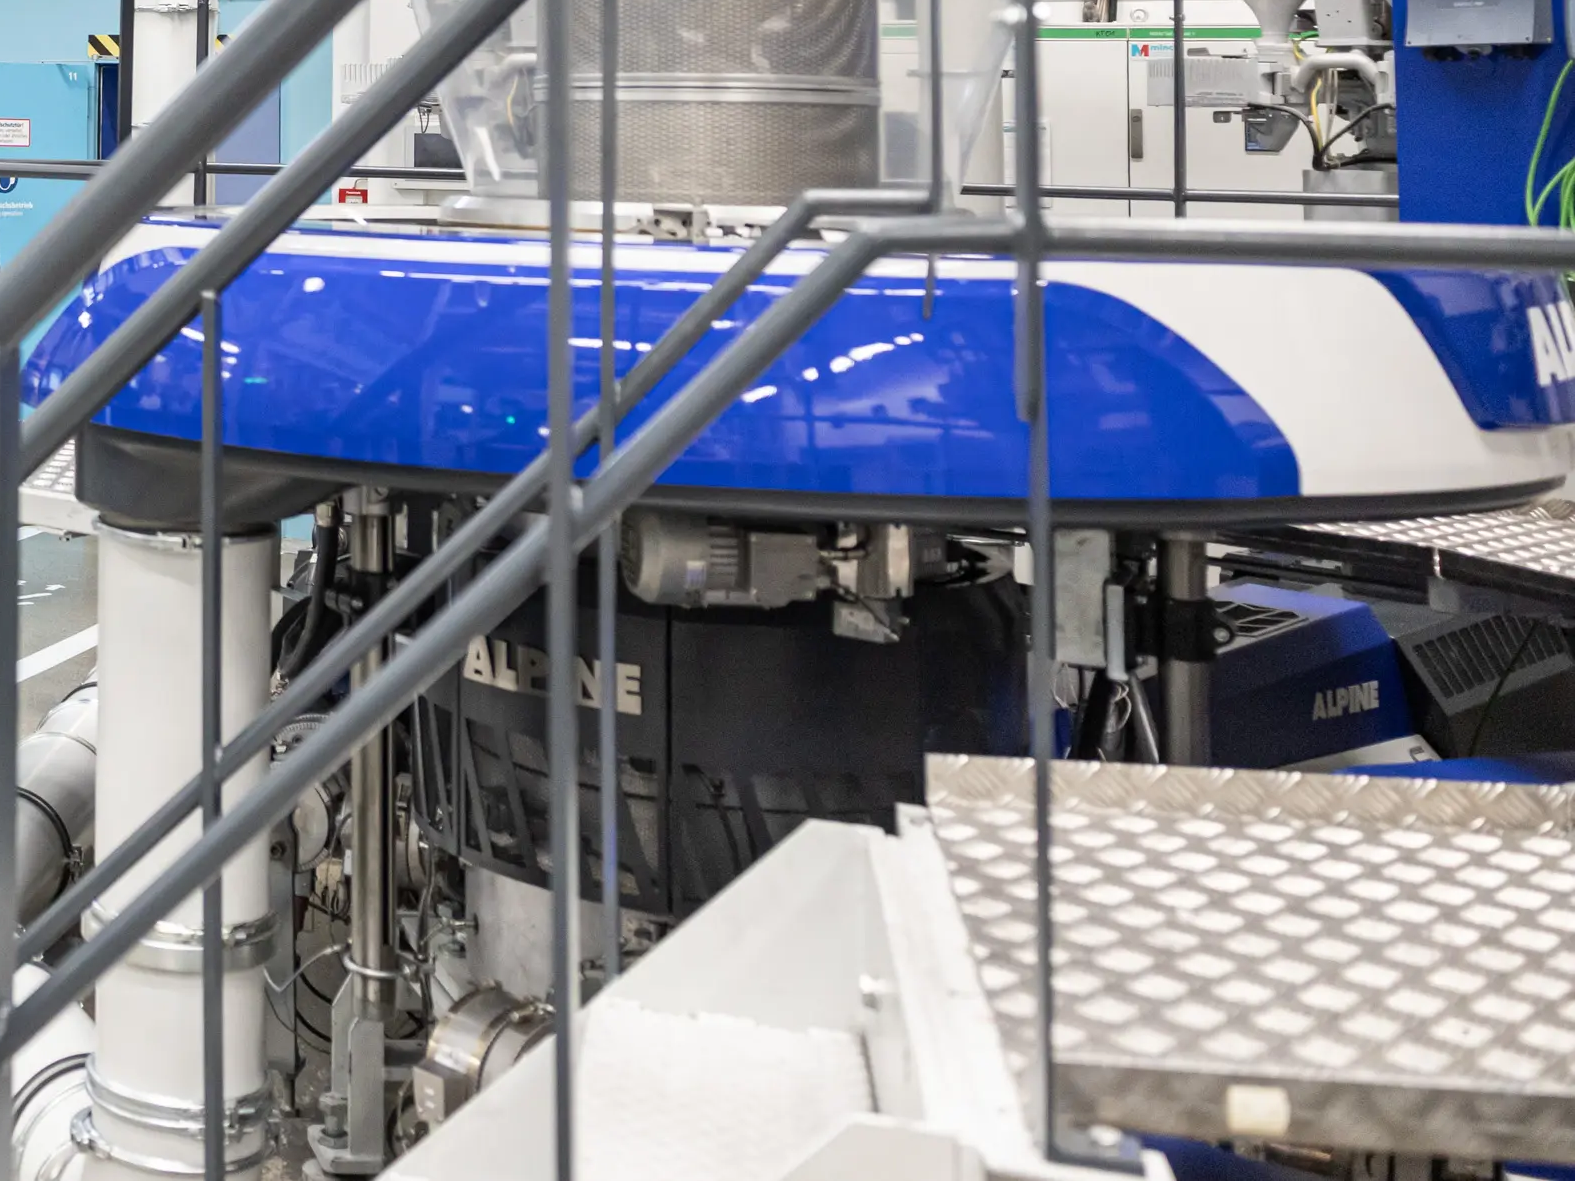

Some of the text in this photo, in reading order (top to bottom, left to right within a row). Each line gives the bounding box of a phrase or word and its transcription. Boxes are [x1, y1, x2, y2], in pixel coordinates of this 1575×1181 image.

[68, 72, 78, 81] 11
[463, 634, 642, 716] ALPNE
[1312, 680, 1380, 721] ALPINE
